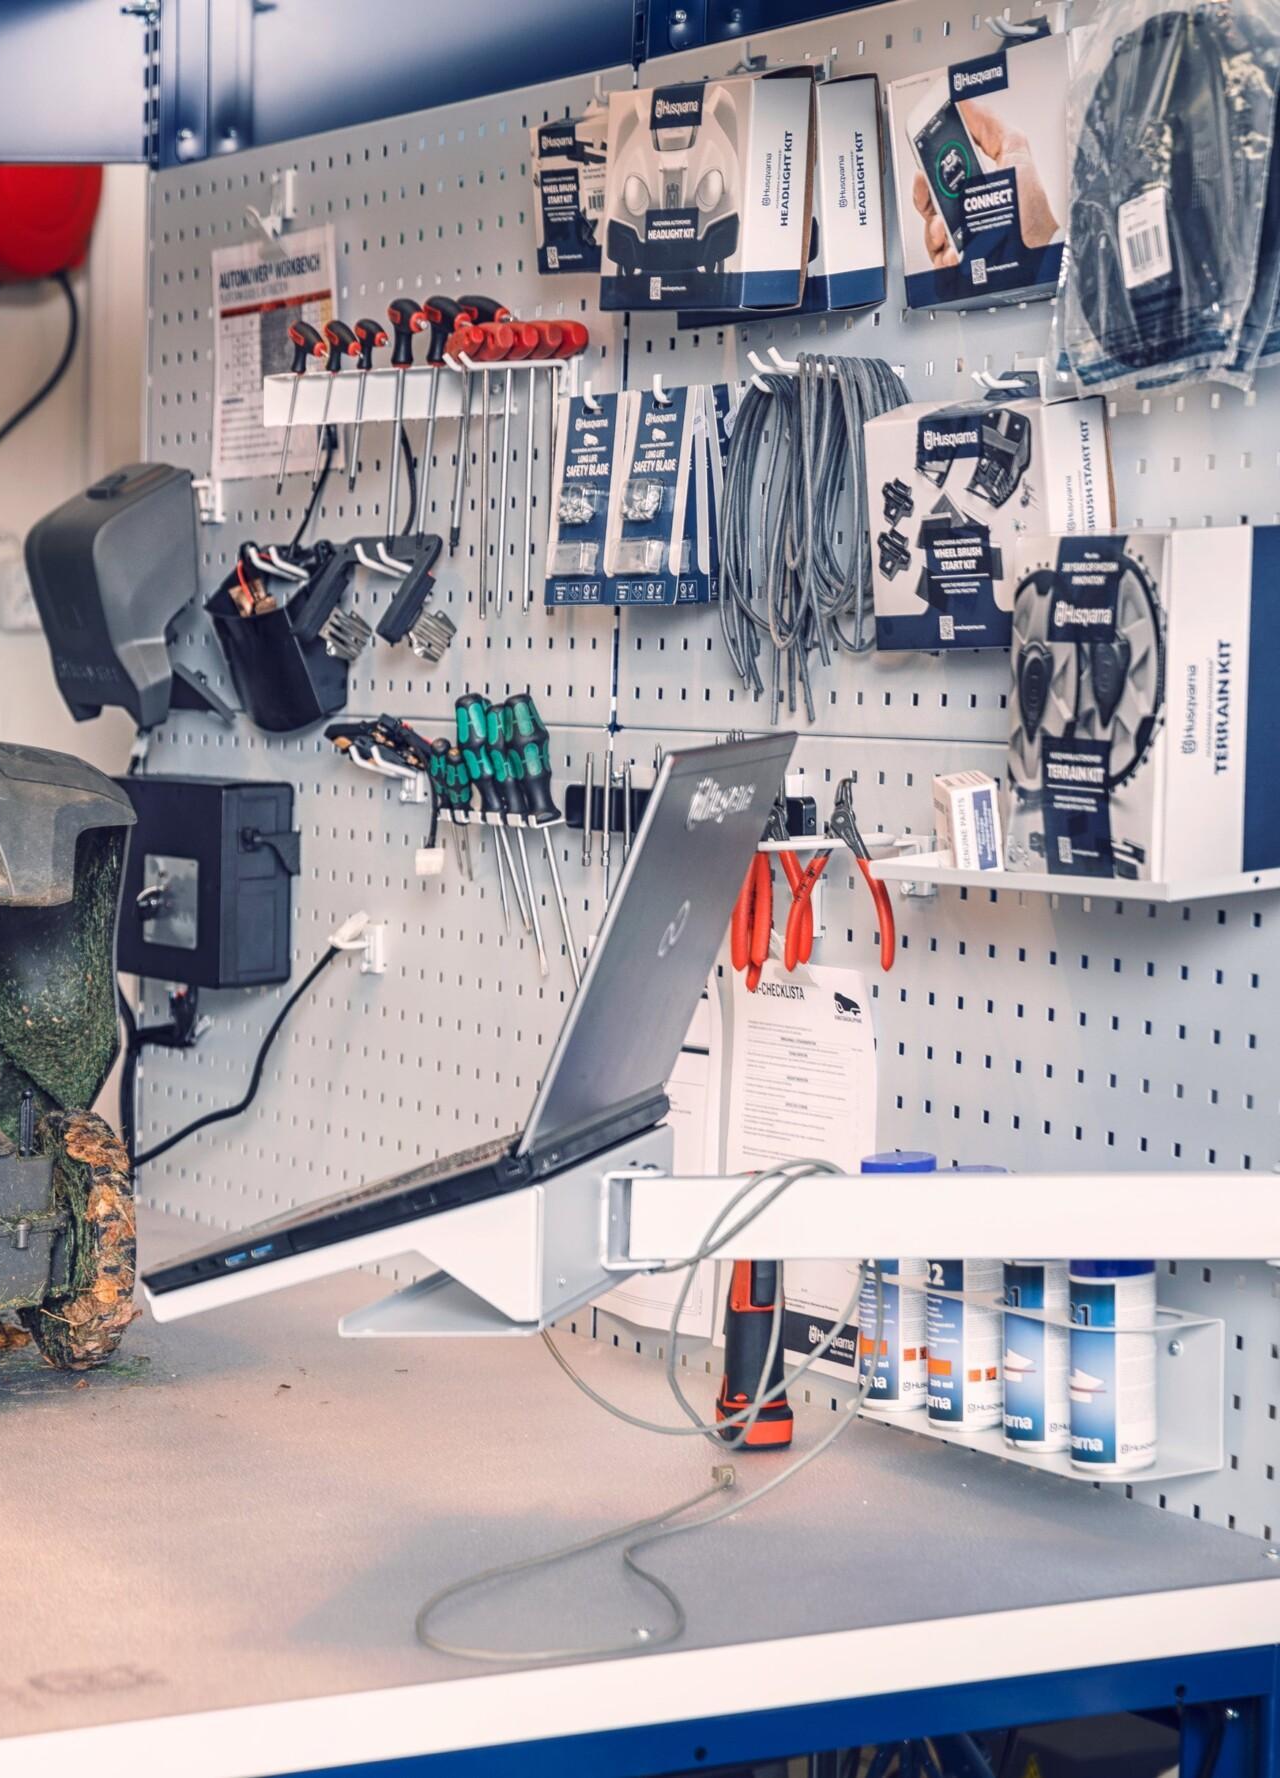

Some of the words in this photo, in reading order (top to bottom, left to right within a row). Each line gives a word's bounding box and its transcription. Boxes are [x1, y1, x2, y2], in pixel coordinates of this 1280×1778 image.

[961, 65, 1003, 86] Husqvarna
[662, 100, 699, 116] Husqvarna
[784, 130, 793, 152] KIT
[854, 131, 863, 153] KIT
[763, 152, 773, 197] Husqvarna
[838, 155, 847, 199] Husqvarna
[780, 154, 792, 227] HEADLIGHT
[855, 154, 867, 226] HEADLIGHT
[963, 188, 1014, 212] CONNECT
[647, 229, 683, 240] HEADLIGHT
[683, 228, 696, 239] KIT
[275, 253, 320, 279] WORKBENCH
[931, 430, 979, 449] Husqvarna
[1080, 420, 1090, 442] KIT
[566, 464, 588, 477] SAFETY
[588, 463, 609, 476] BLADE
[633, 460, 655, 473] SAFETY
[655, 459, 677, 471] BLADE
[1082, 445, 1093, 486] START
[933, 547, 957, 559] WHEEL
[957, 546, 983, 558] BRUSH
[941, 560, 963, 571] START
[963, 559, 977, 570] KIT
[1064, 604, 1113, 627] Husqvarna
[1217, 639, 1231, 674] KIT
[1183, 665, 1198, 738] Husqvarna
[1214, 679, 1230, 775] TERRAIN
[1046, 763, 1086, 781] TERRAIN
[1086, 767, 1105, 783] KIT
